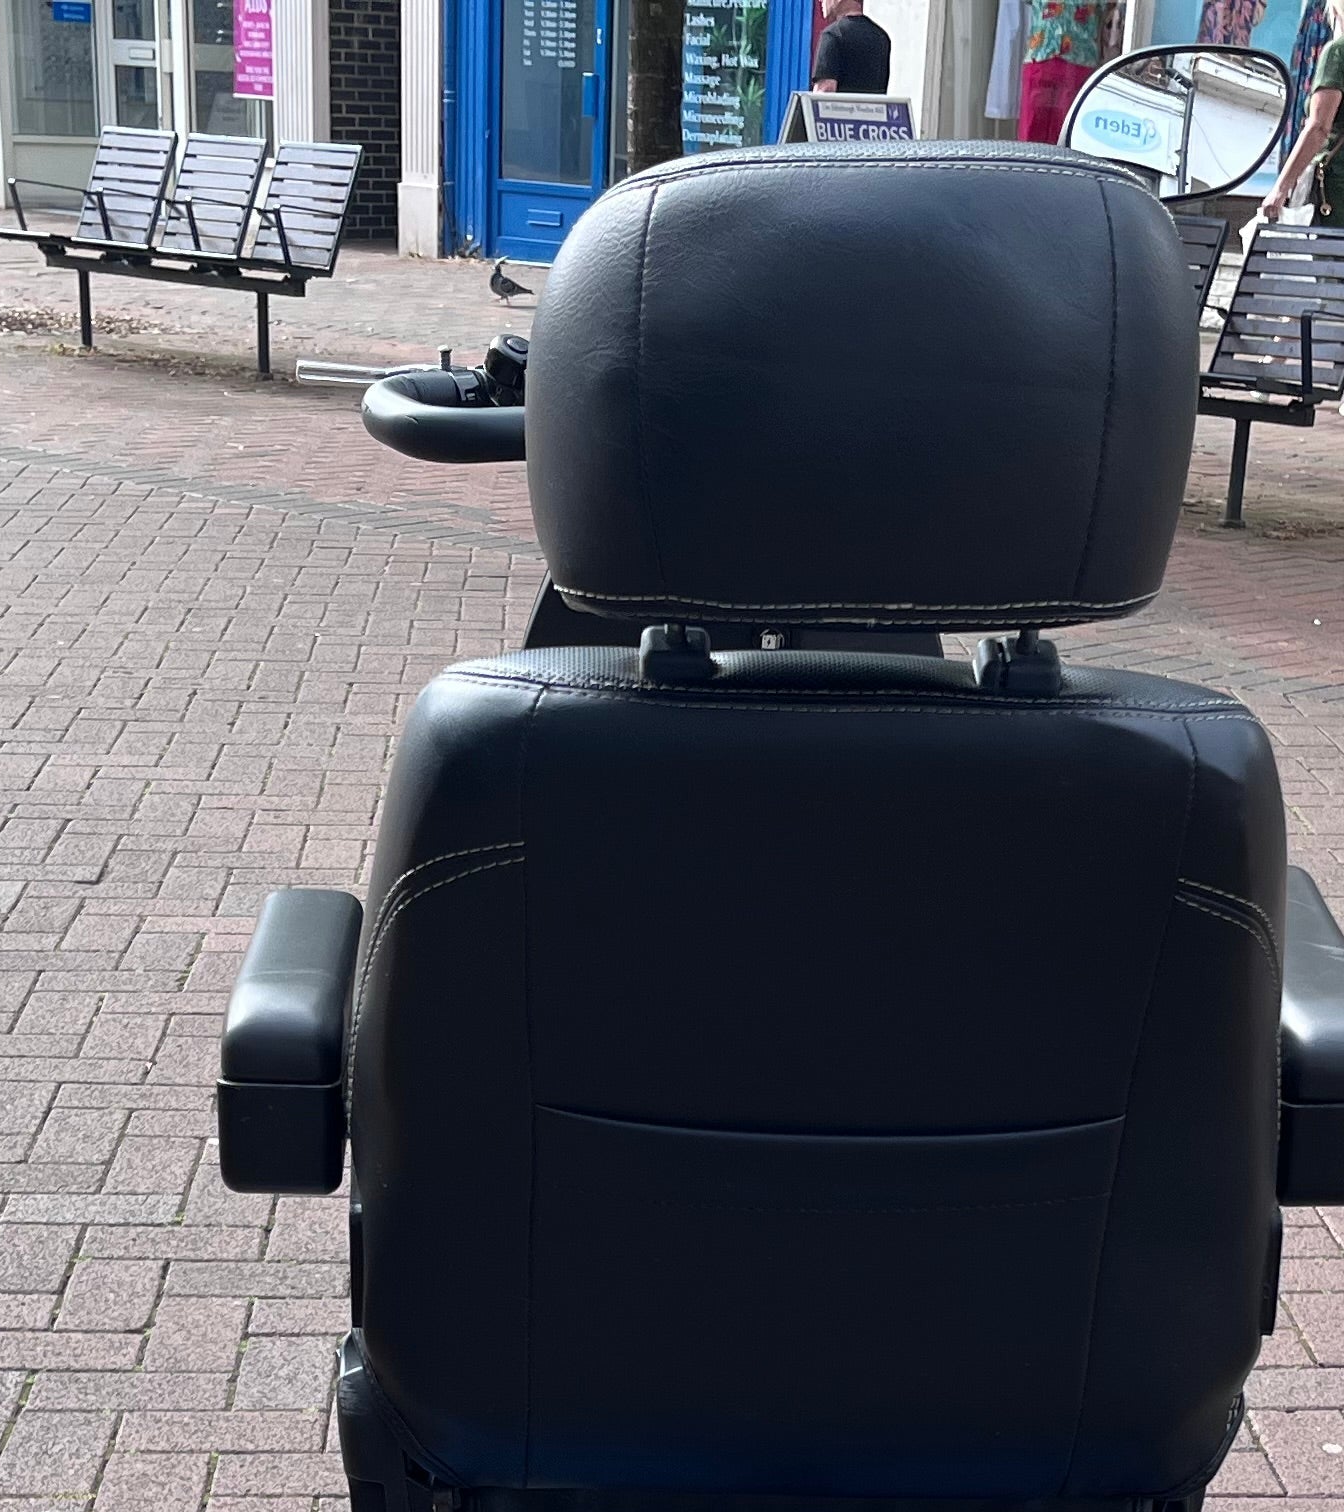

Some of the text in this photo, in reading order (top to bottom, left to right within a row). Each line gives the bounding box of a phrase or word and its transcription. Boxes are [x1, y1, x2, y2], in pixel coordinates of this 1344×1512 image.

[685, 12, 715, 27] Lashes
[685, 32, 711, 46] Facial
[684, 72, 721, 88] Massage
[683, 90, 740, 109] Microblading
[682, 109, 744, 129] Microneedling
[682, 128, 742, 147] Dermaplaning
[816, 121, 911, 141] BLUE CROSS
